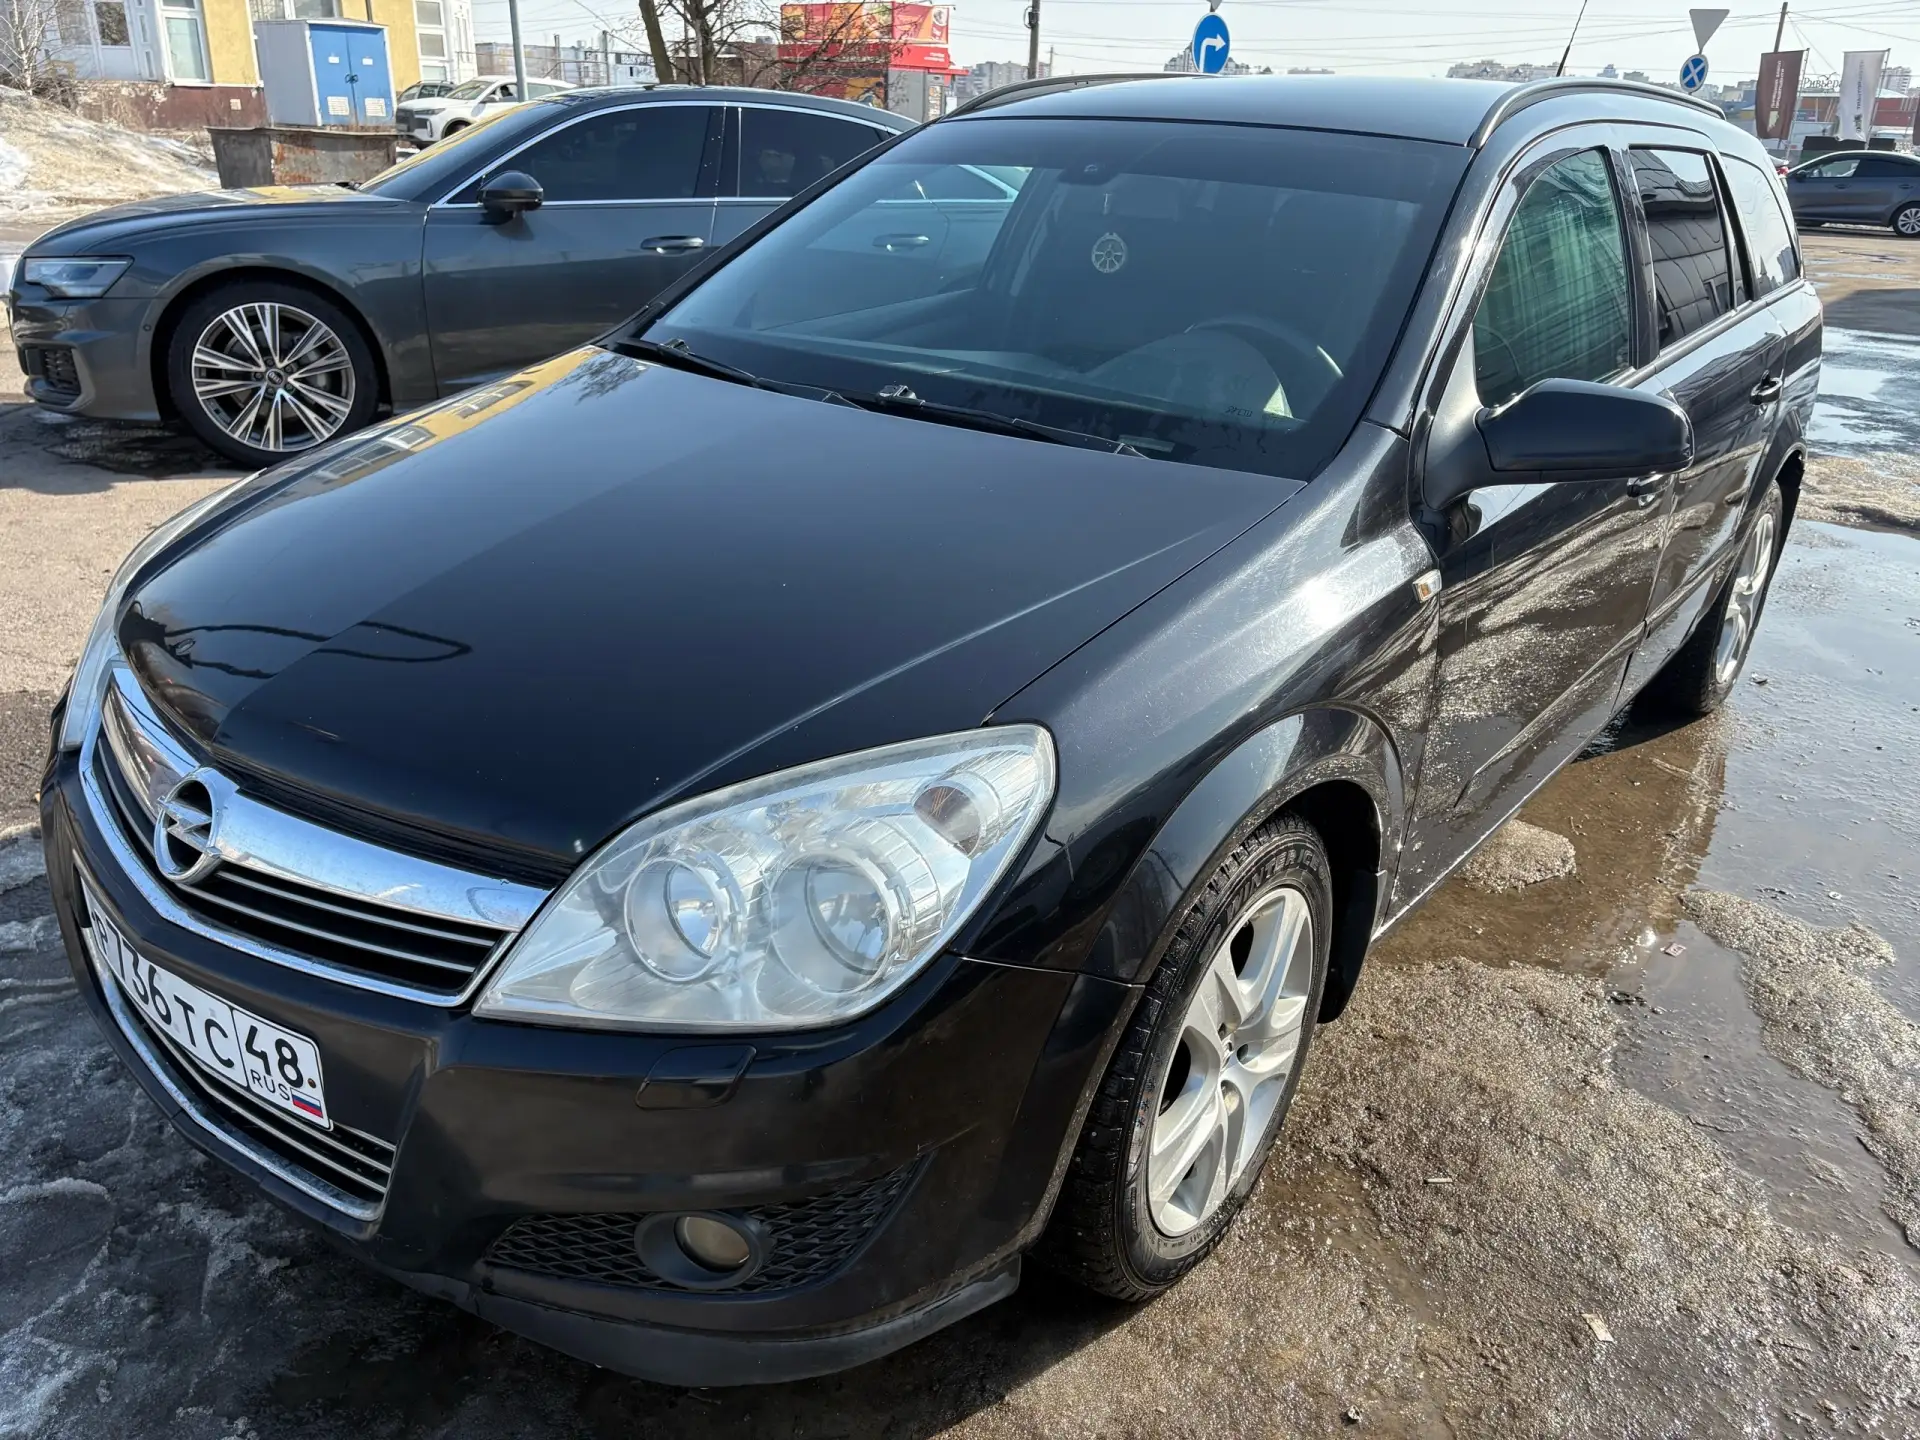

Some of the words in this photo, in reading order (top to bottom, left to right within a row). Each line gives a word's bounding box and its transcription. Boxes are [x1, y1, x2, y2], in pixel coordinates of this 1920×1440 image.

[1803, 77, 1841, 89] Ривьер
[1226, 849, 1297, 924] WINTER
[1297, 849, 1320, 871] ICE
[245, 1025, 304, 1088] 48
[251, 1070, 291, 1101] RUS
